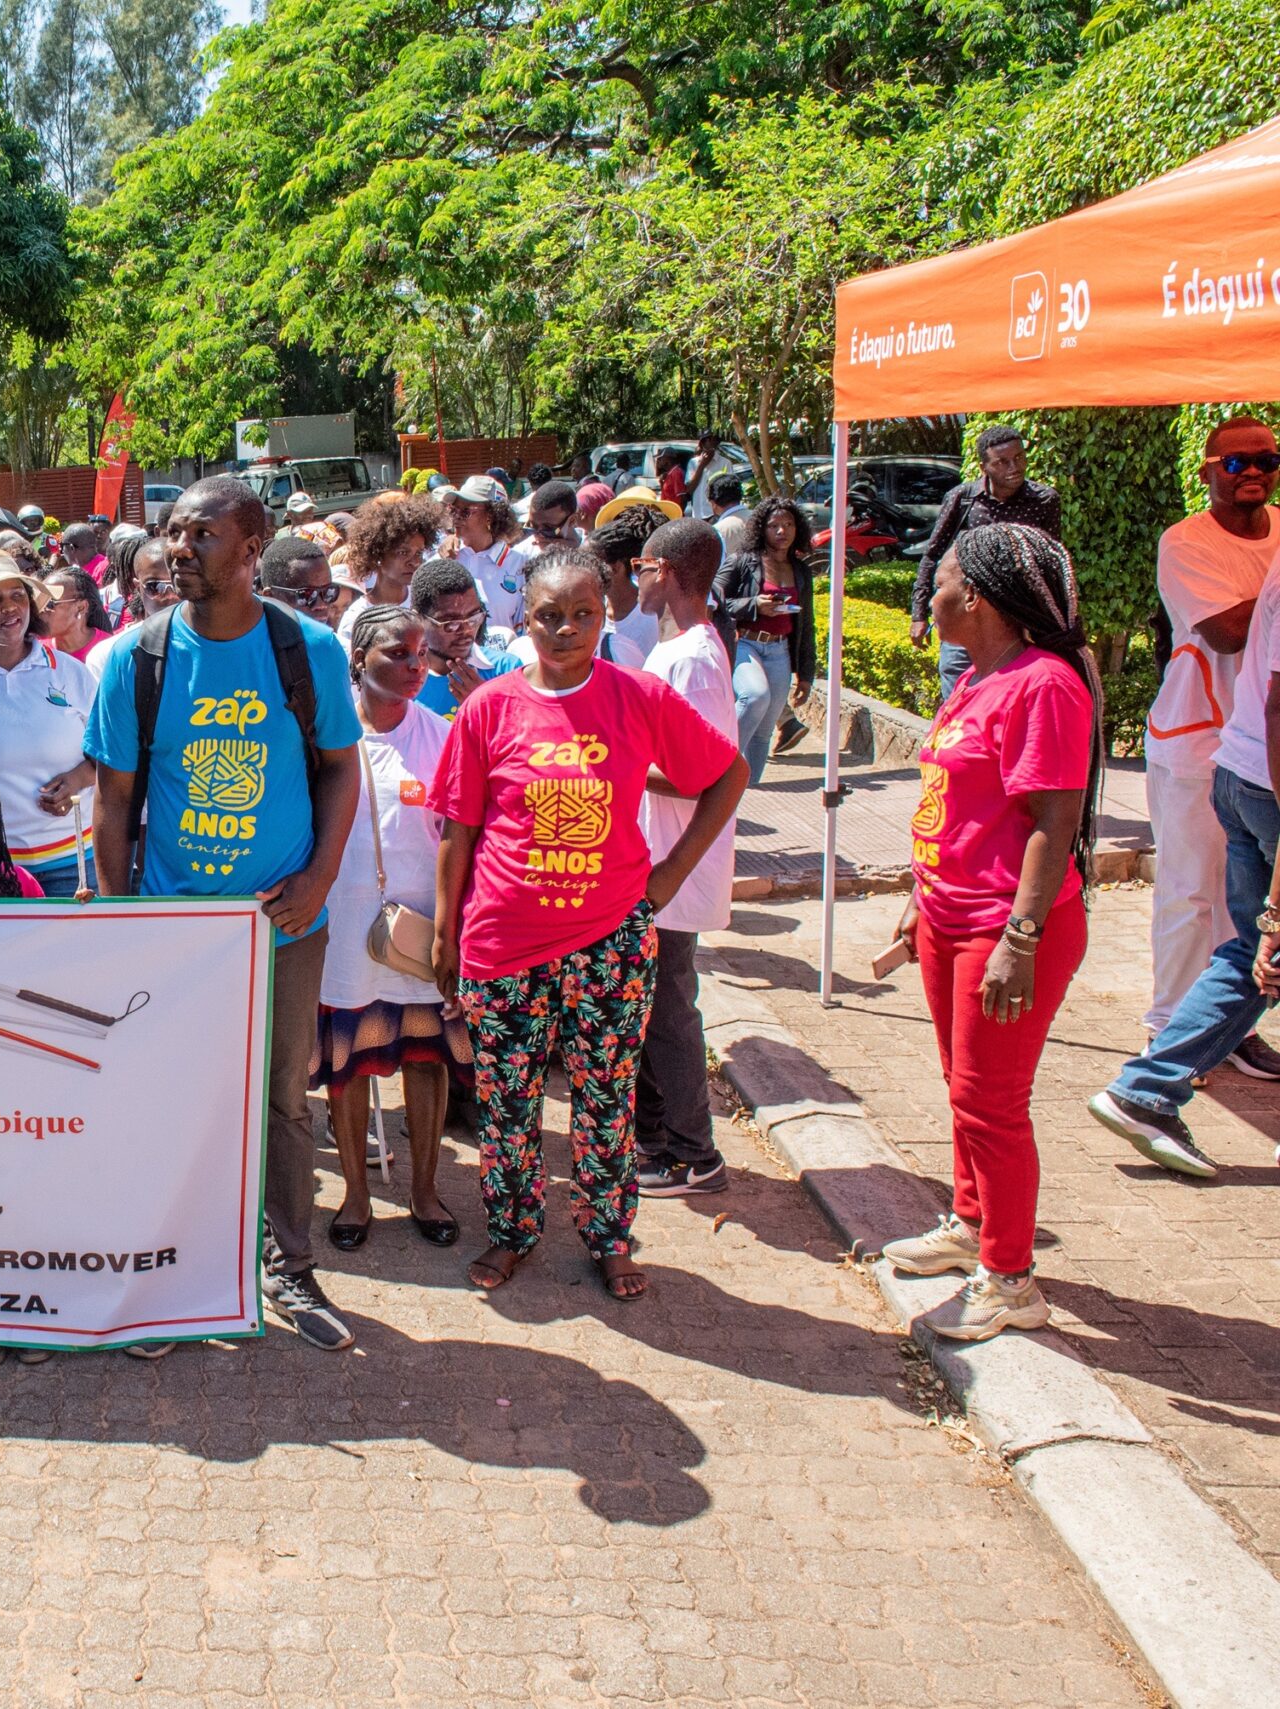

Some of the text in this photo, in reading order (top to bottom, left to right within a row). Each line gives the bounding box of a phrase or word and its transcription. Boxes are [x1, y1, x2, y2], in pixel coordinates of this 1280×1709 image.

[1058, 279, 1090, 333] 30
[1162, 261, 1178, 318] É
[1183, 257, 1265, 326] daqui
[850, 321, 956, 369] É daqui o futuro.
[1015, 314, 1037, 339] BCI
[180, 808, 257, 840] ANOS
[526, 848, 604, 875] ANOS
